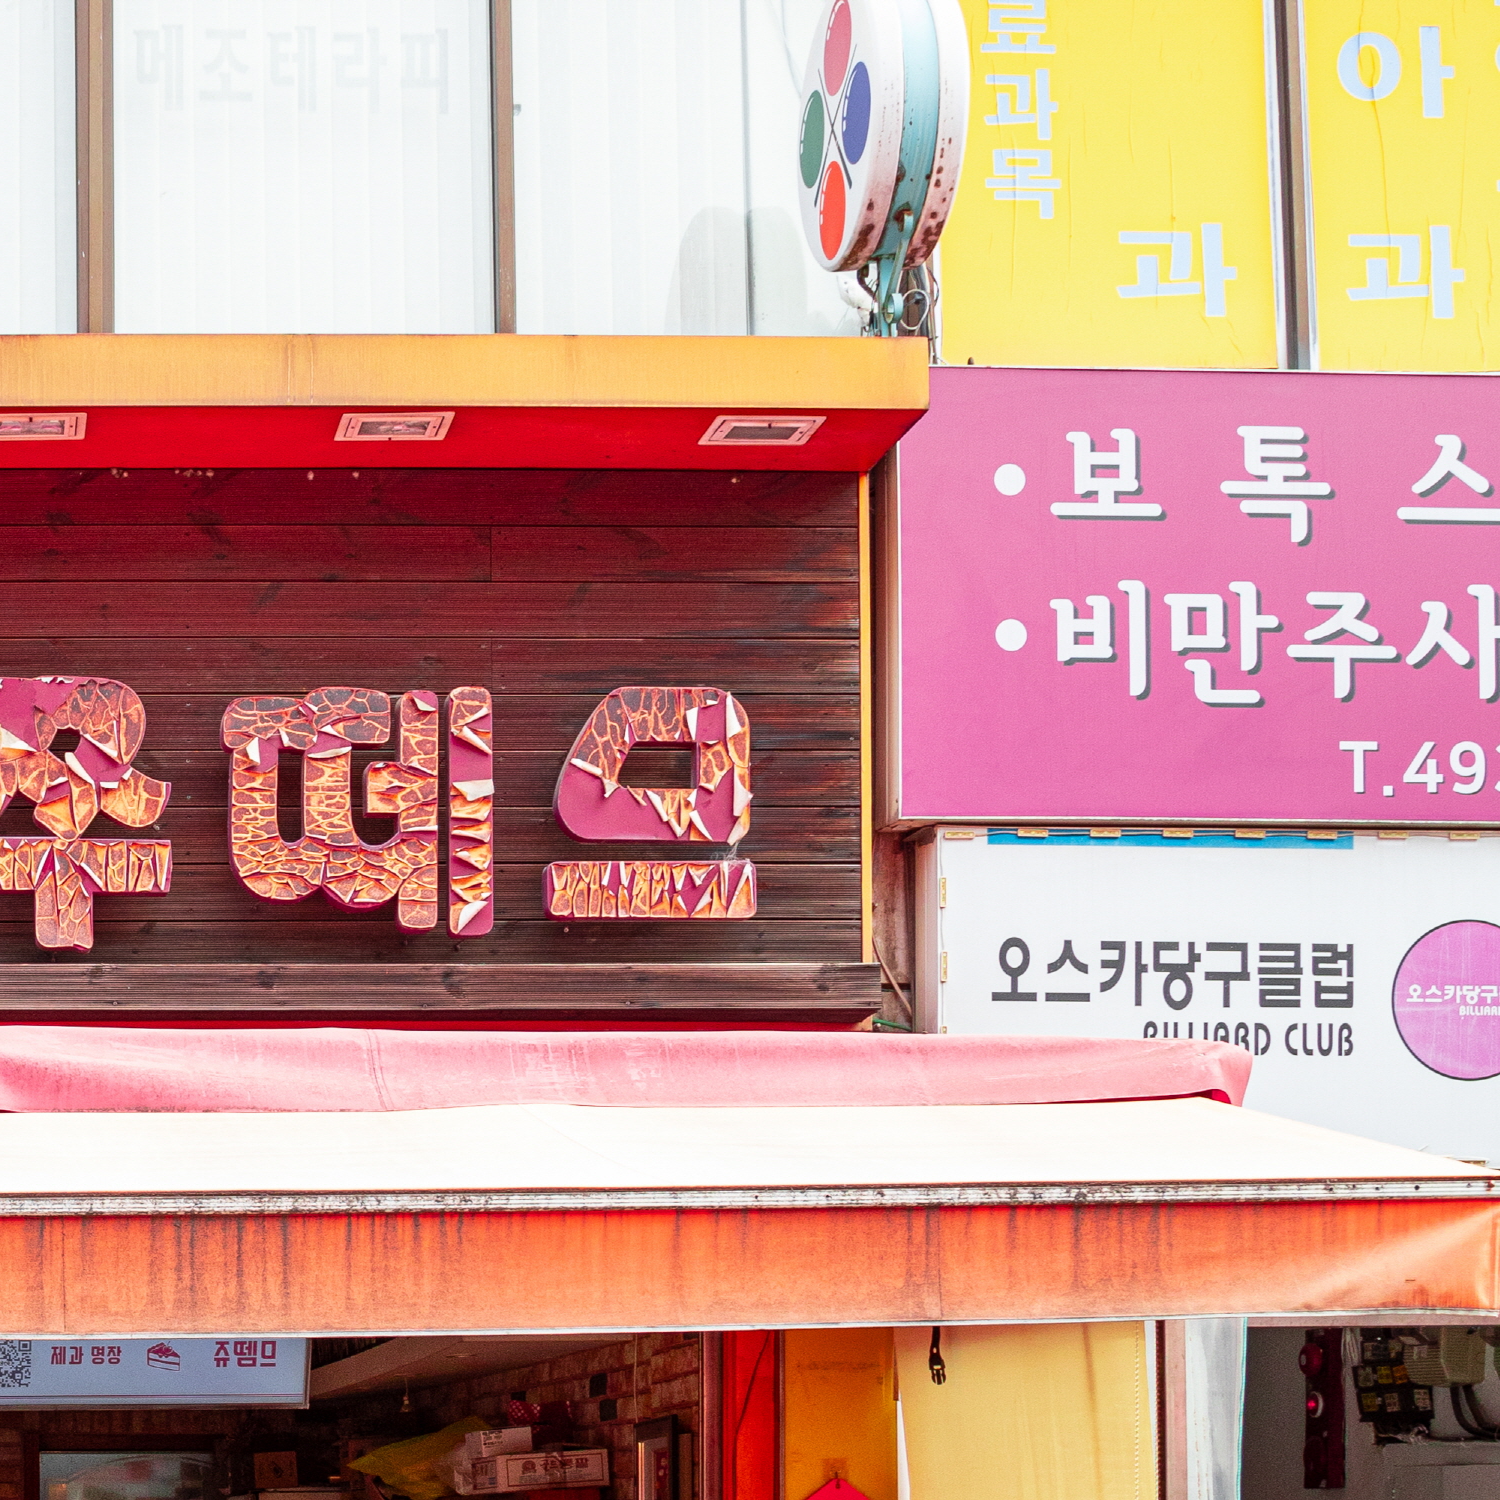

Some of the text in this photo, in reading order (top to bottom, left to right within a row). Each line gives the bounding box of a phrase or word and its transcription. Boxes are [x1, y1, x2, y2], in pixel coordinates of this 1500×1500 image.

[1050, 425, 1500, 543] 보톡스
[1339, 741, 1500, 797] T.49
[991, 936, 1355, 1011] 오스카당구클럽
[1406, 983, 1500, 1005] 오스카당구
[1285, 1022, 1354, 1056] CLUB
[50, 1345, 122, 1365] 제과 명장
